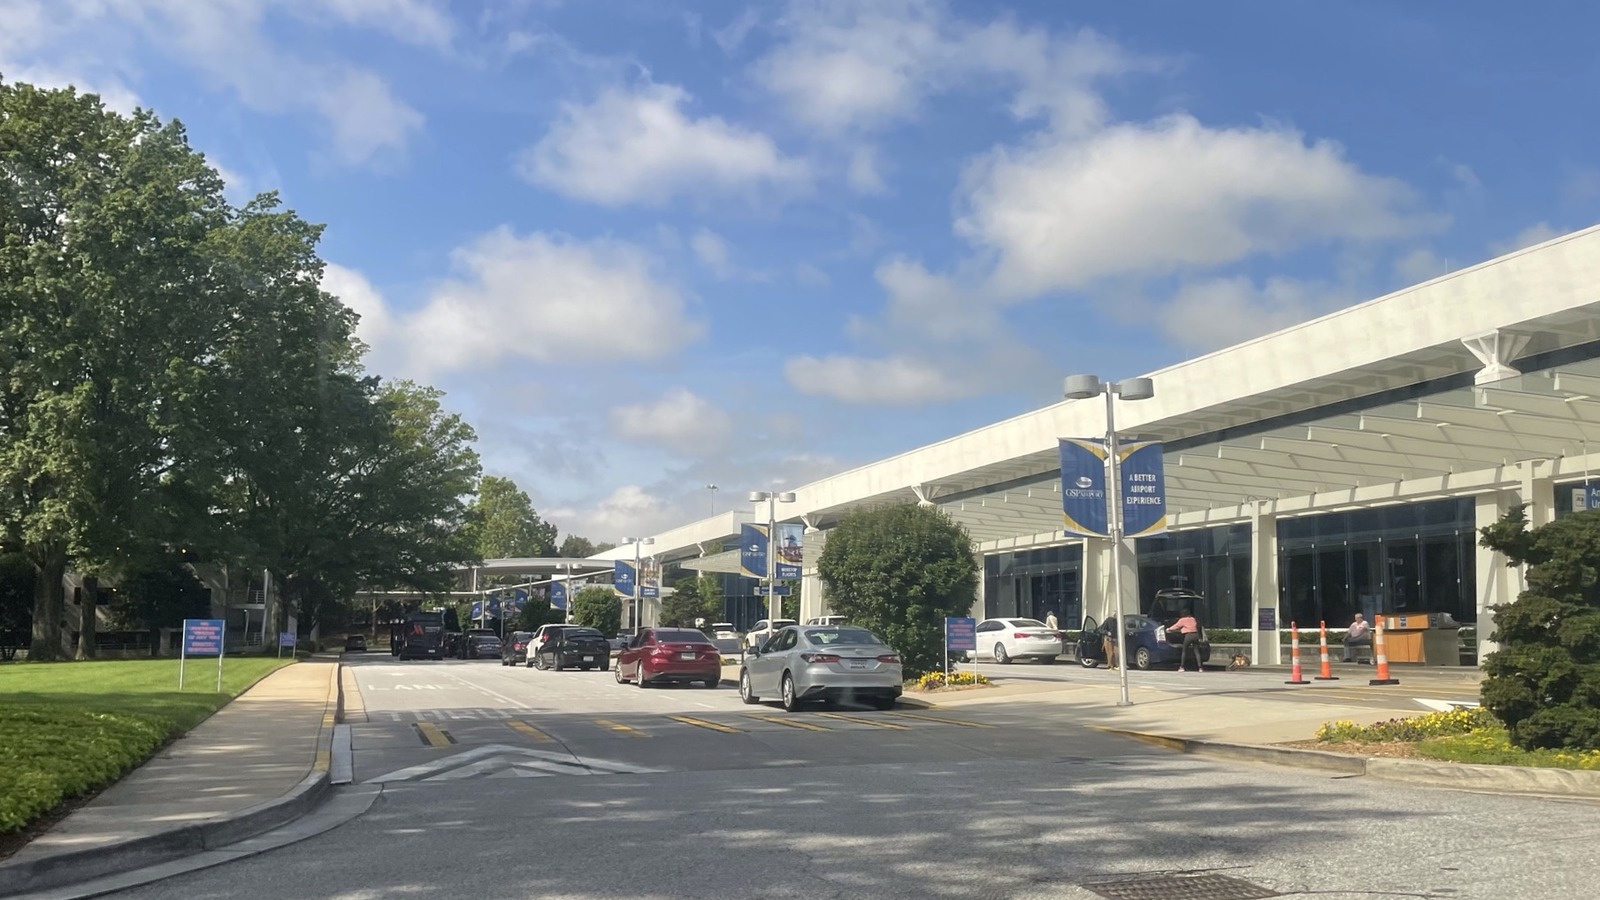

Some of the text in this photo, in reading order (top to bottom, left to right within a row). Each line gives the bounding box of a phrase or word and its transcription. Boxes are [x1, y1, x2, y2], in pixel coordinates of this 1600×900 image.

[1134, 474, 1156, 482] BETTER
[1131, 485, 1156, 493] AIRPORT
[1126, 496, 1161, 505] EXPERIENCE
